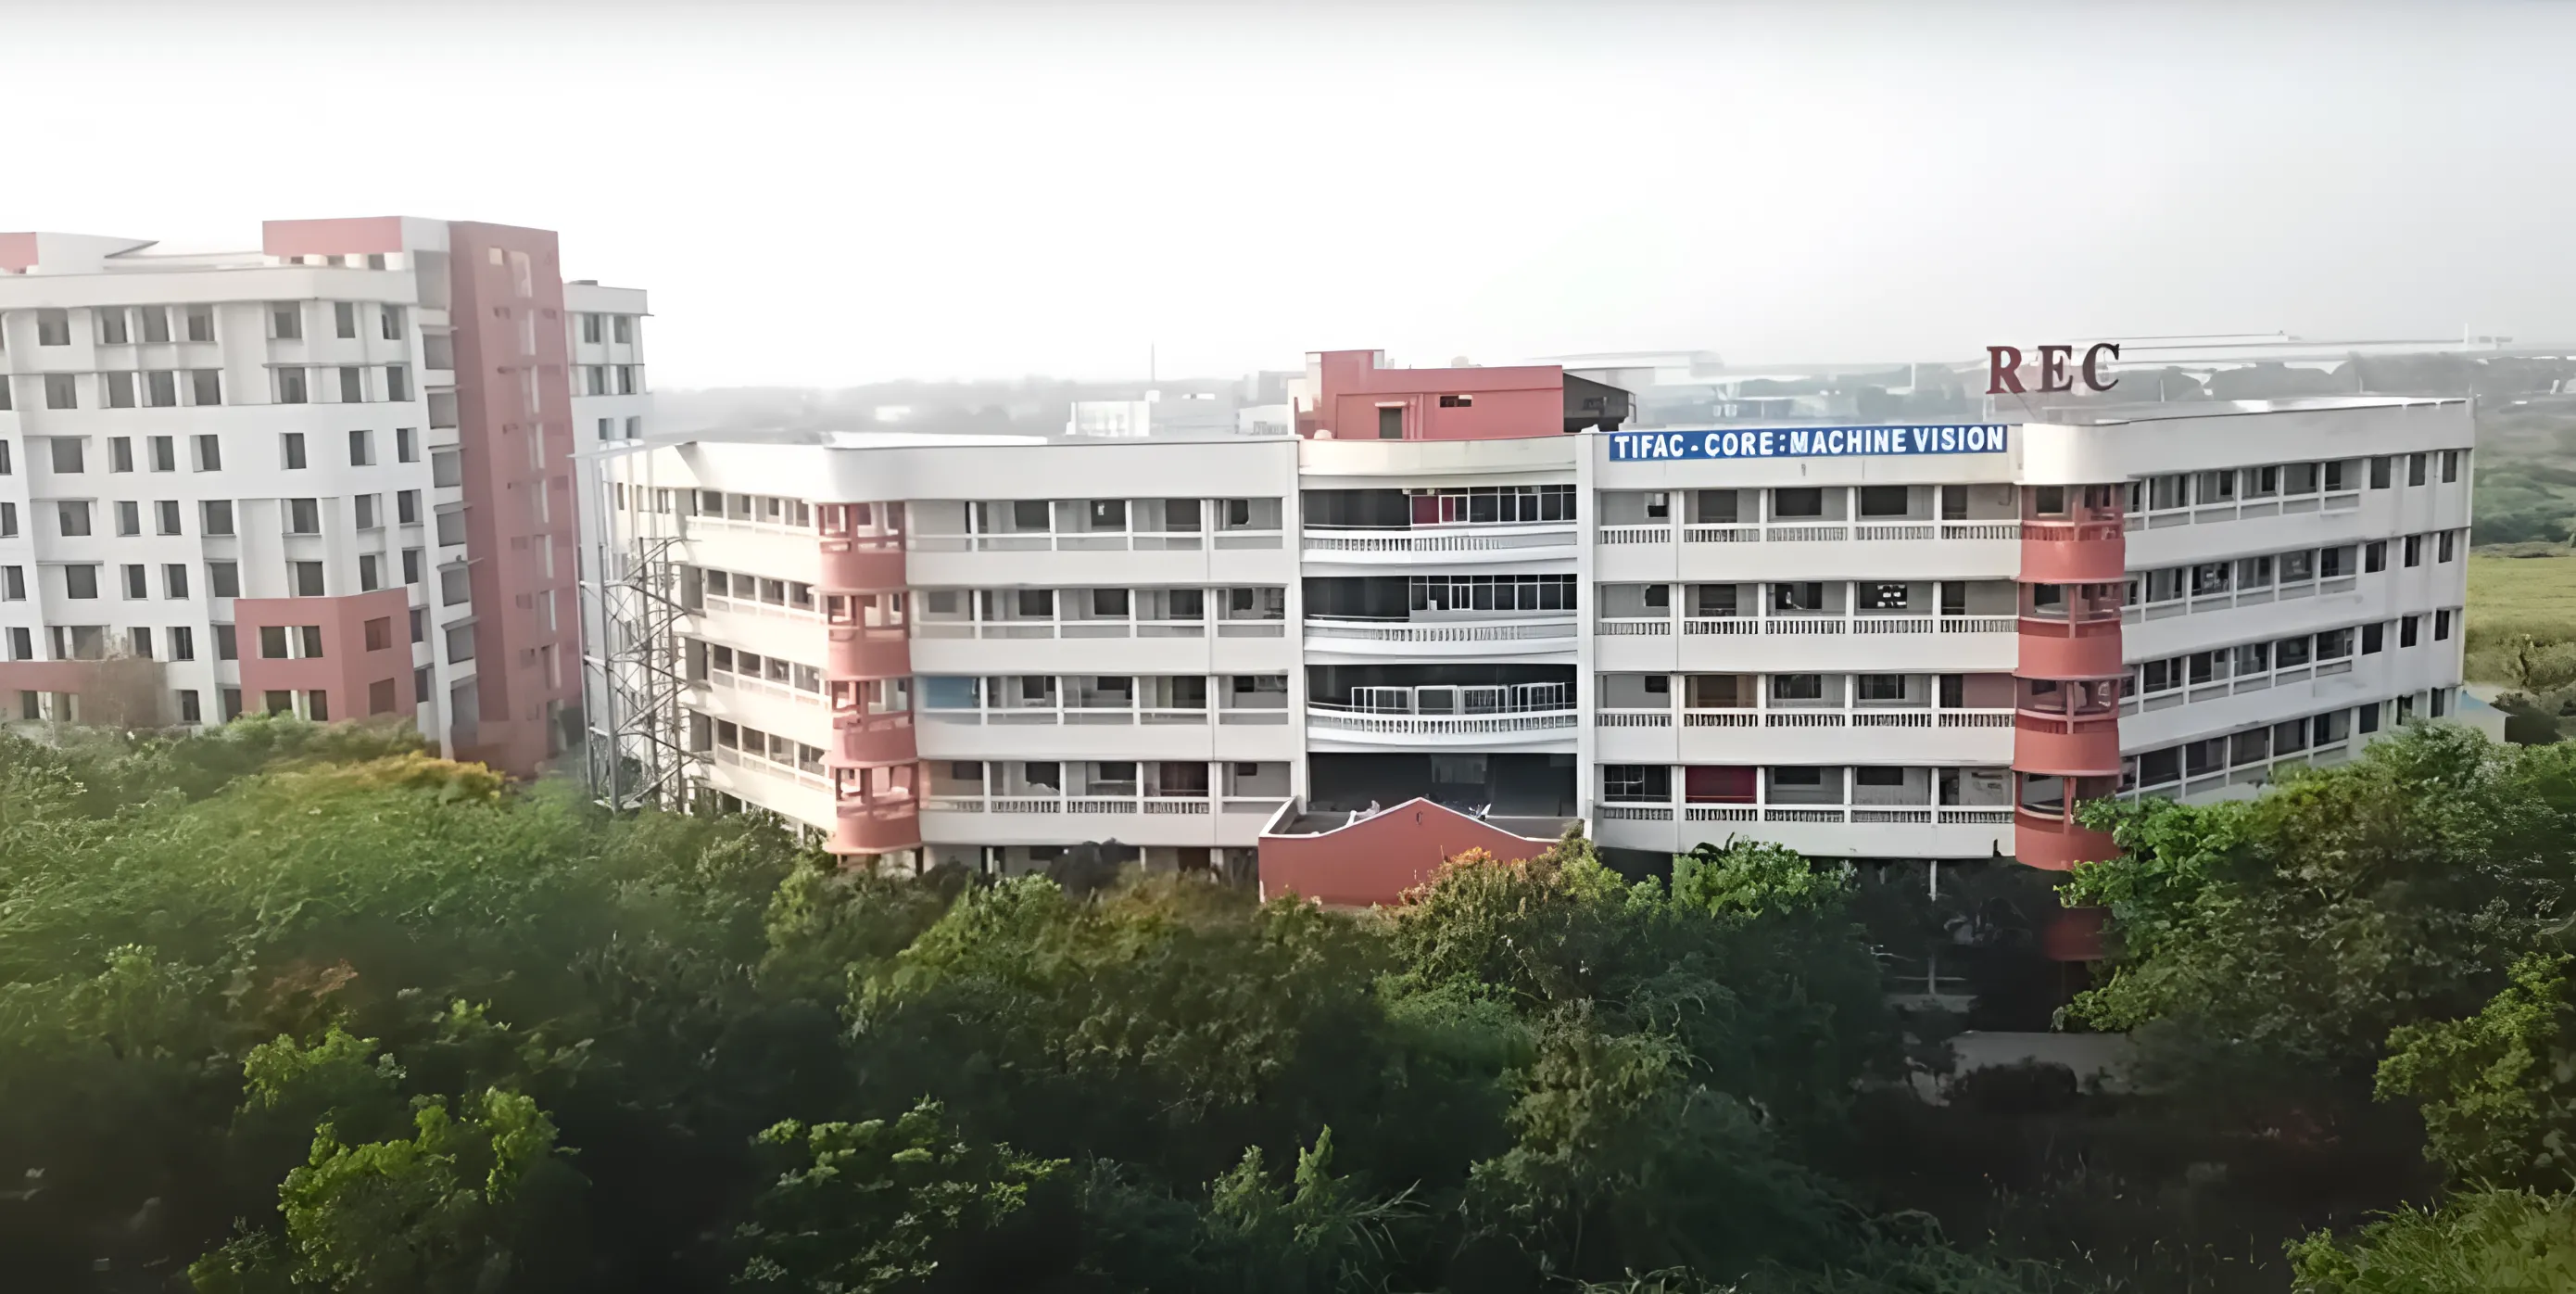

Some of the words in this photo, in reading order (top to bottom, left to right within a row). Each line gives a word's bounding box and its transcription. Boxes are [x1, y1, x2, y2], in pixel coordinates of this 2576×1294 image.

[1986, 343, 2120, 394] REC
[1614, 434, 1685, 458] TIFAC
[1913, 426, 2003, 451] VISION
